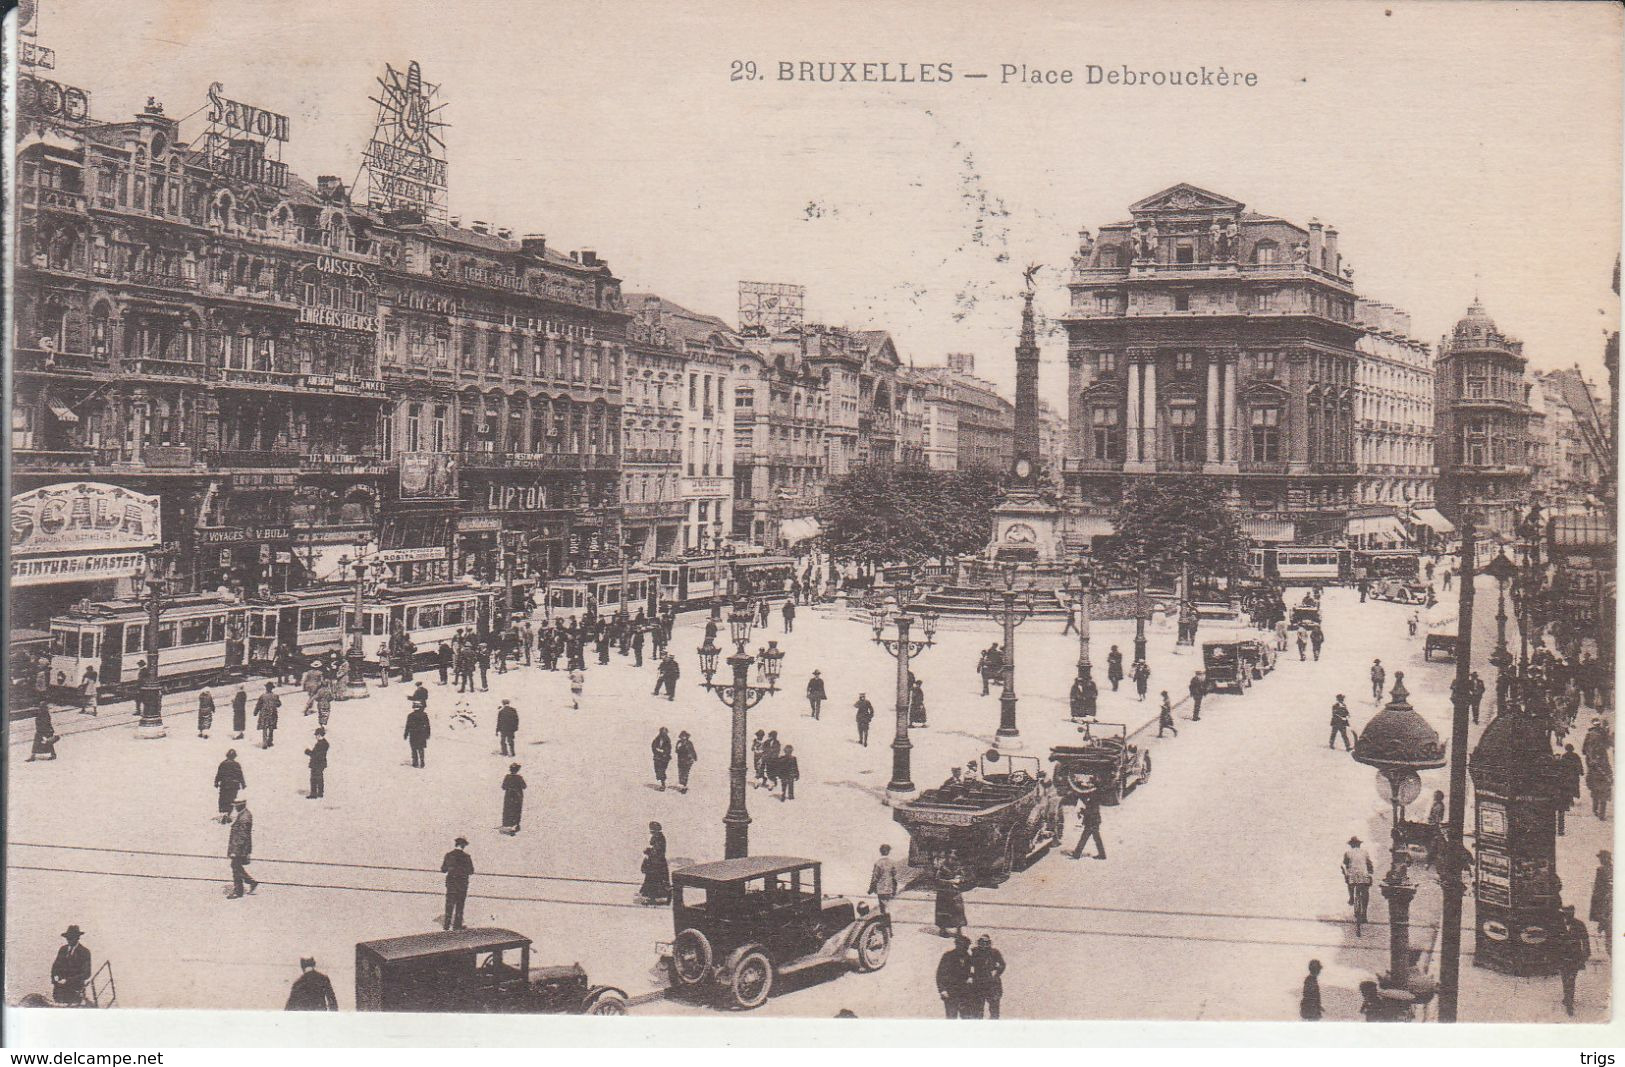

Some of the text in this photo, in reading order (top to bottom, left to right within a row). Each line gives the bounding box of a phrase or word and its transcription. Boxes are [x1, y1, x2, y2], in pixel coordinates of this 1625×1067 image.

[208, 81, 289, 142] Savon
[316, 255, 365, 278] CAISSES
[488, 486, 548, 510] LIPTON
[12, 497, 145, 546] SCALA
[209, 530, 245, 542] VOYAGES
[264, 527, 290, 539] BULL
